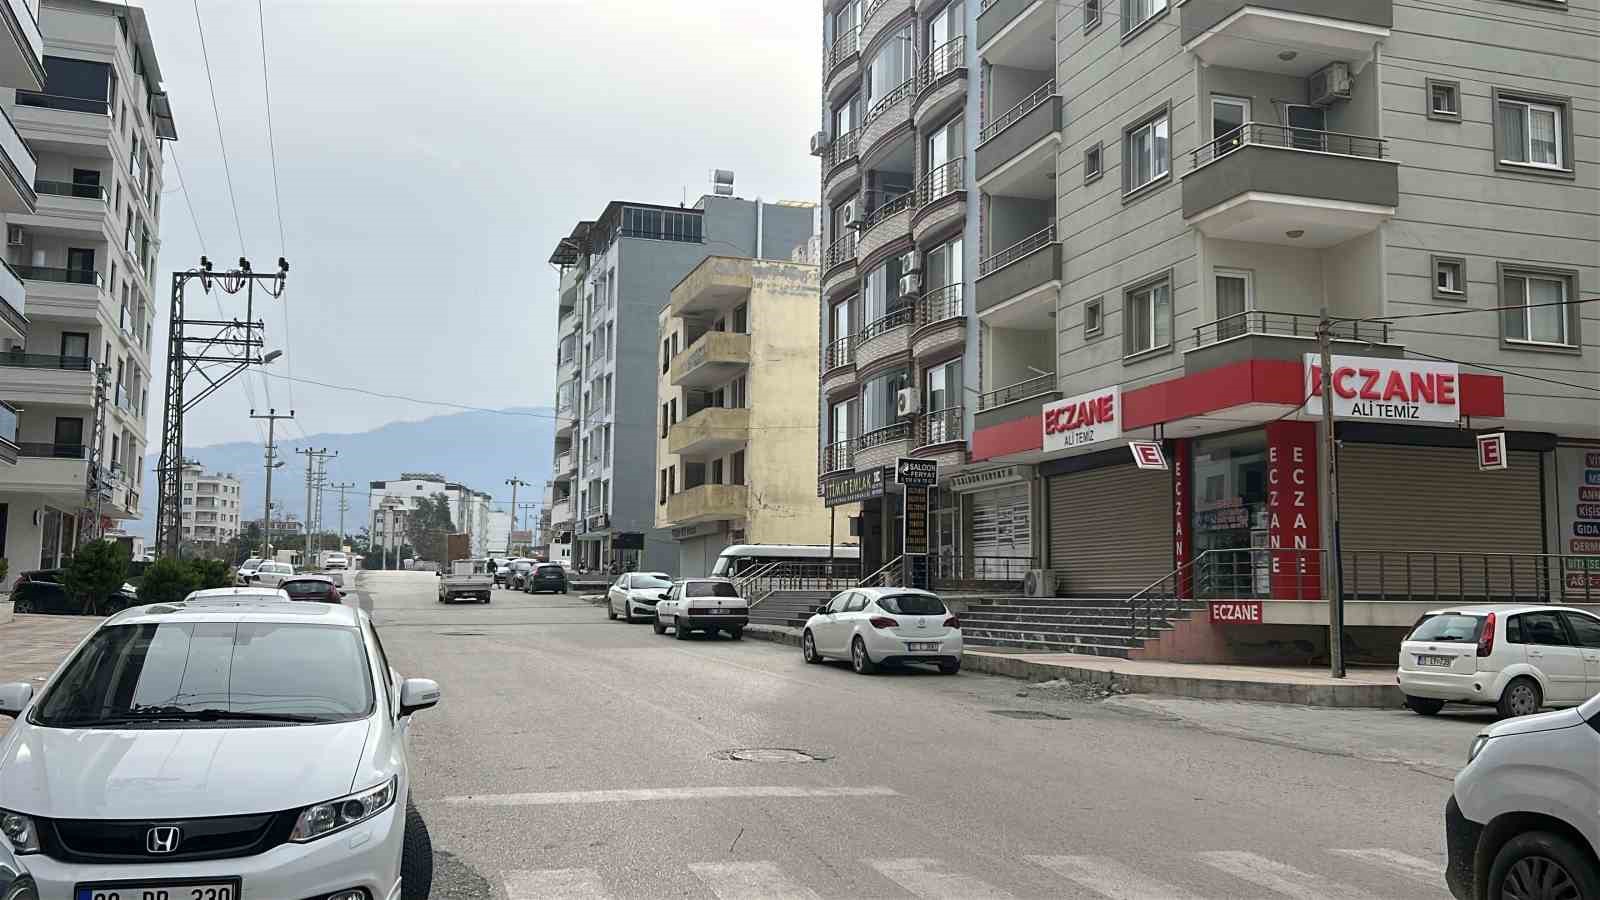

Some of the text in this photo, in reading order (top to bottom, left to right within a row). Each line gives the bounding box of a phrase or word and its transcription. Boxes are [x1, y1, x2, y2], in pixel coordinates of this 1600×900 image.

[1045, 394, 1114, 435] ECZANE
[1351, 401, 1419, 419] ALİ TEMİZ
[1064, 430, 1094, 446] ALİ TEMİZ
[1140, 447, 1160, 463] E
[1483, 441, 1498, 463] E
[1270, 447, 1281, 573] ECZANE
[1213, 604, 1258, 620] ECZANE
